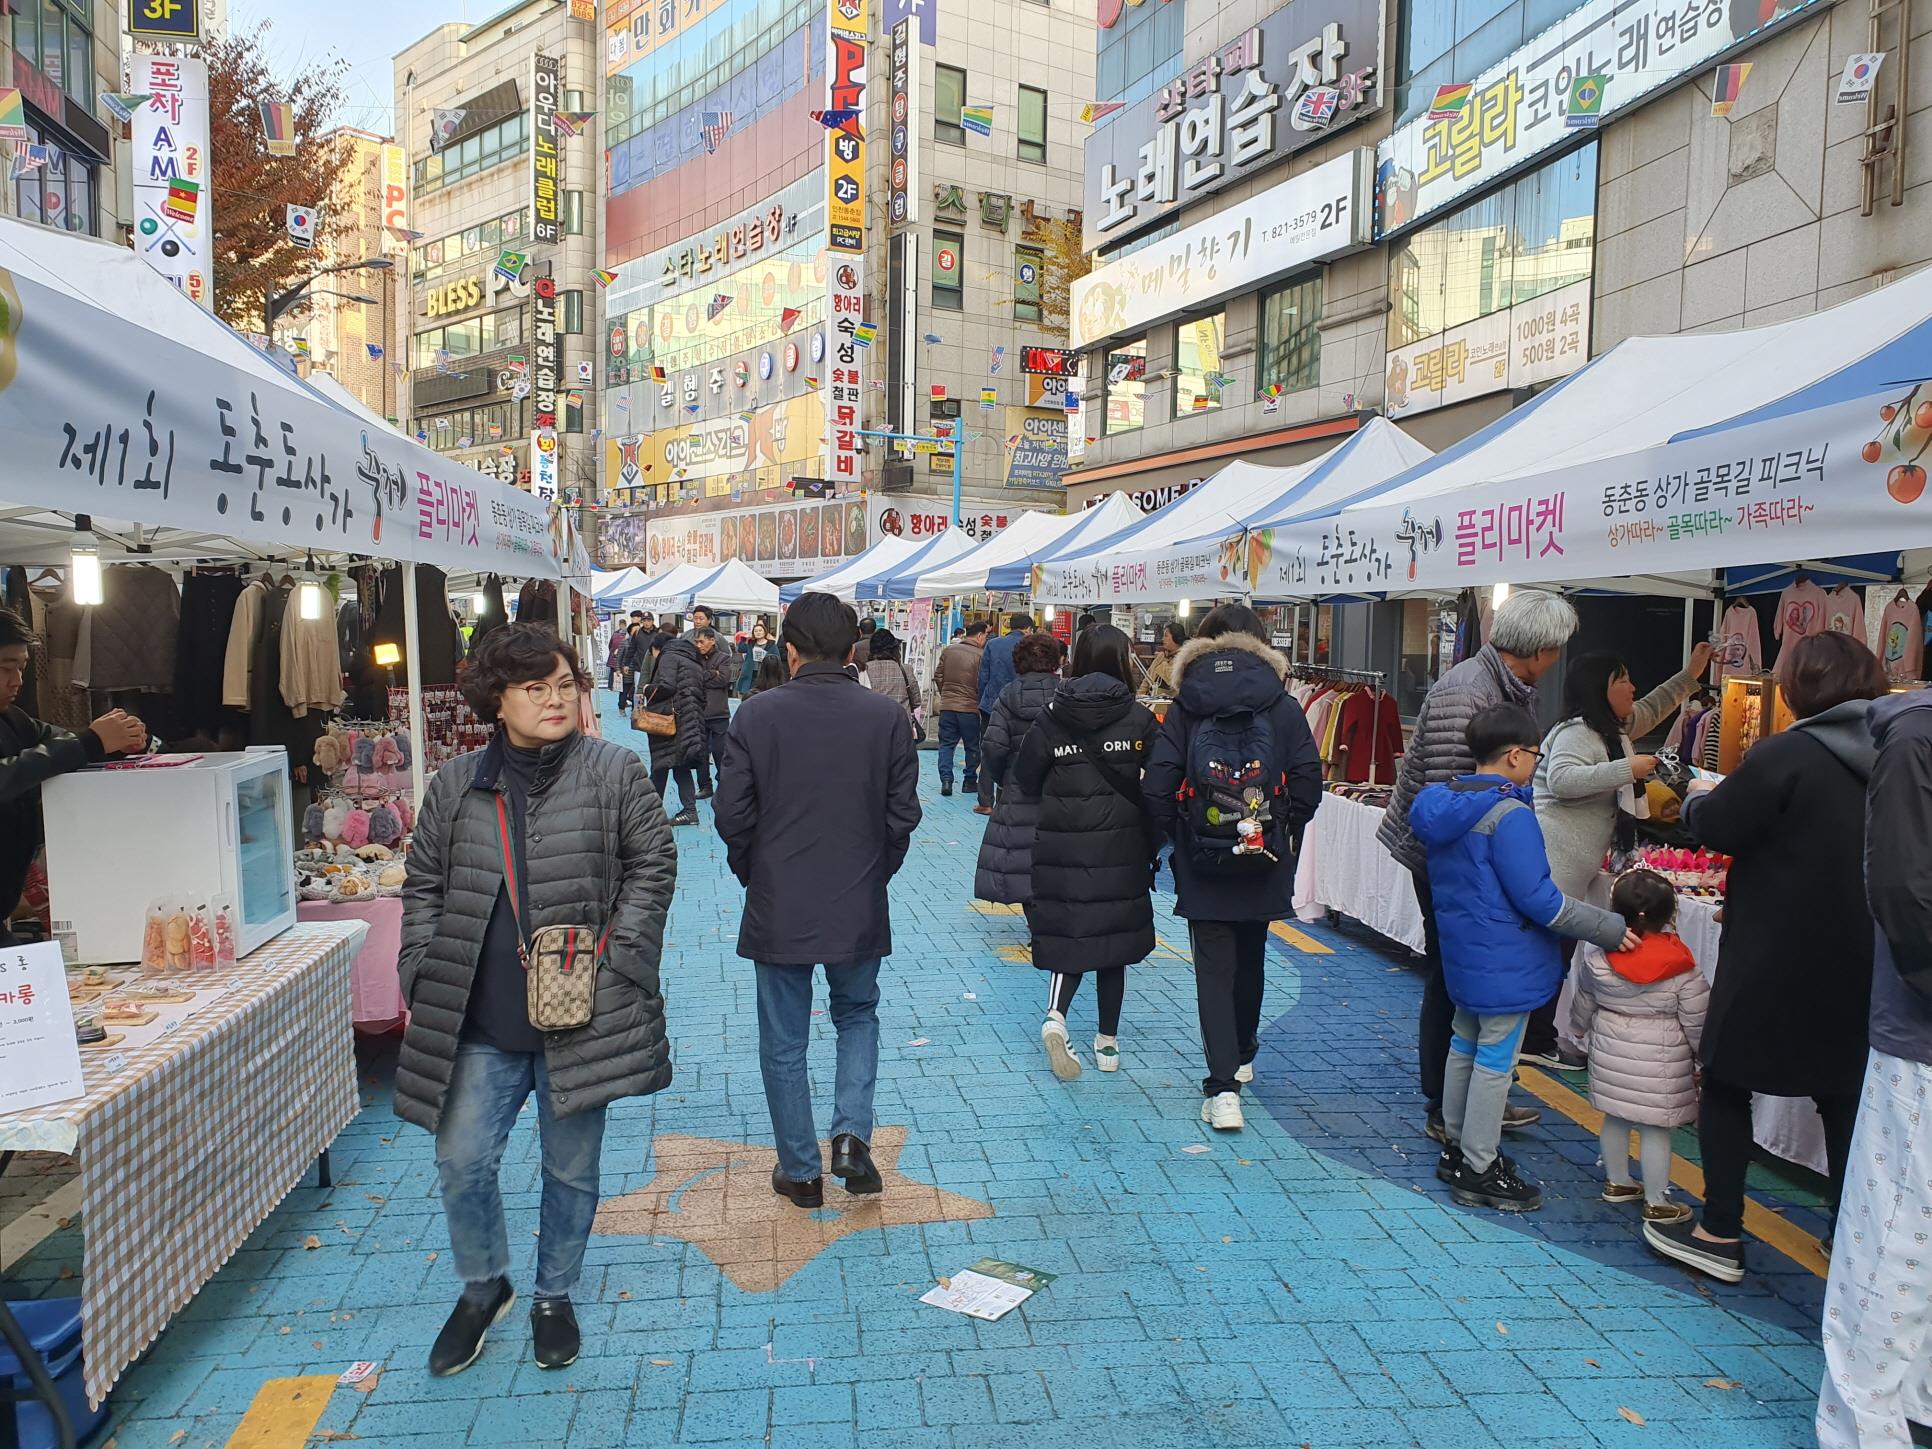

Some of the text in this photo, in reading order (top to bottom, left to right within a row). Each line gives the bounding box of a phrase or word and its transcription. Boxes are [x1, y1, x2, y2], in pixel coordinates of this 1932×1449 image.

[149, 61, 183, 125] 포차
[839, 138, 856, 160] 방
[1096, 22, 1346, 232] 노래연습장
[1339, 66, 1374, 110] 3F
[1418, 66, 1526, 187] 고릴라
[535, 72, 556, 238] 아우디 노래클럽 6F
[837, 180, 857, 199] 2F
[1320, 195, 1348, 231] 2F
[165, 208, 195, 222] Welcome
[1272, 210, 1317, 239] 821-3579
[661, 203, 783, 287] 스타노래연습장
[427, 275, 481, 318] BLESS
[833, 293, 862, 315] 항아리
[836, 317, 856, 364] 숙성
[1517, 303, 1580, 342] 1000원 4곡
[535, 298, 554, 411] 노래연습장
[1410, 338, 1469, 392] 고릴라
[1522, 331, 1580, 367] 500원 2곡
[836, 405, 856, 476] 닭갈비
[1024, 417, 1068, 436] 아이센
[59, 389, 174, 500] 제1회
[356, 430, 409, 545] 축제
[416, 471, 480, 548] 플리마켓
[1601, 442, 1829, 518] 동춘동 상가 골목길 피크닉
[910, 513, 948, 536] 항아리
[1279, 545, 1306, 585] 제1회
[1394, 506, 1444, 582] 축제
[1455, 492, 1565, 567] 플리마켓
[1607, 495, 1815, 548] 상가따라~ 골목따라~ 가족따라~
[1112, 560, 1147, 593] 플리마켓
